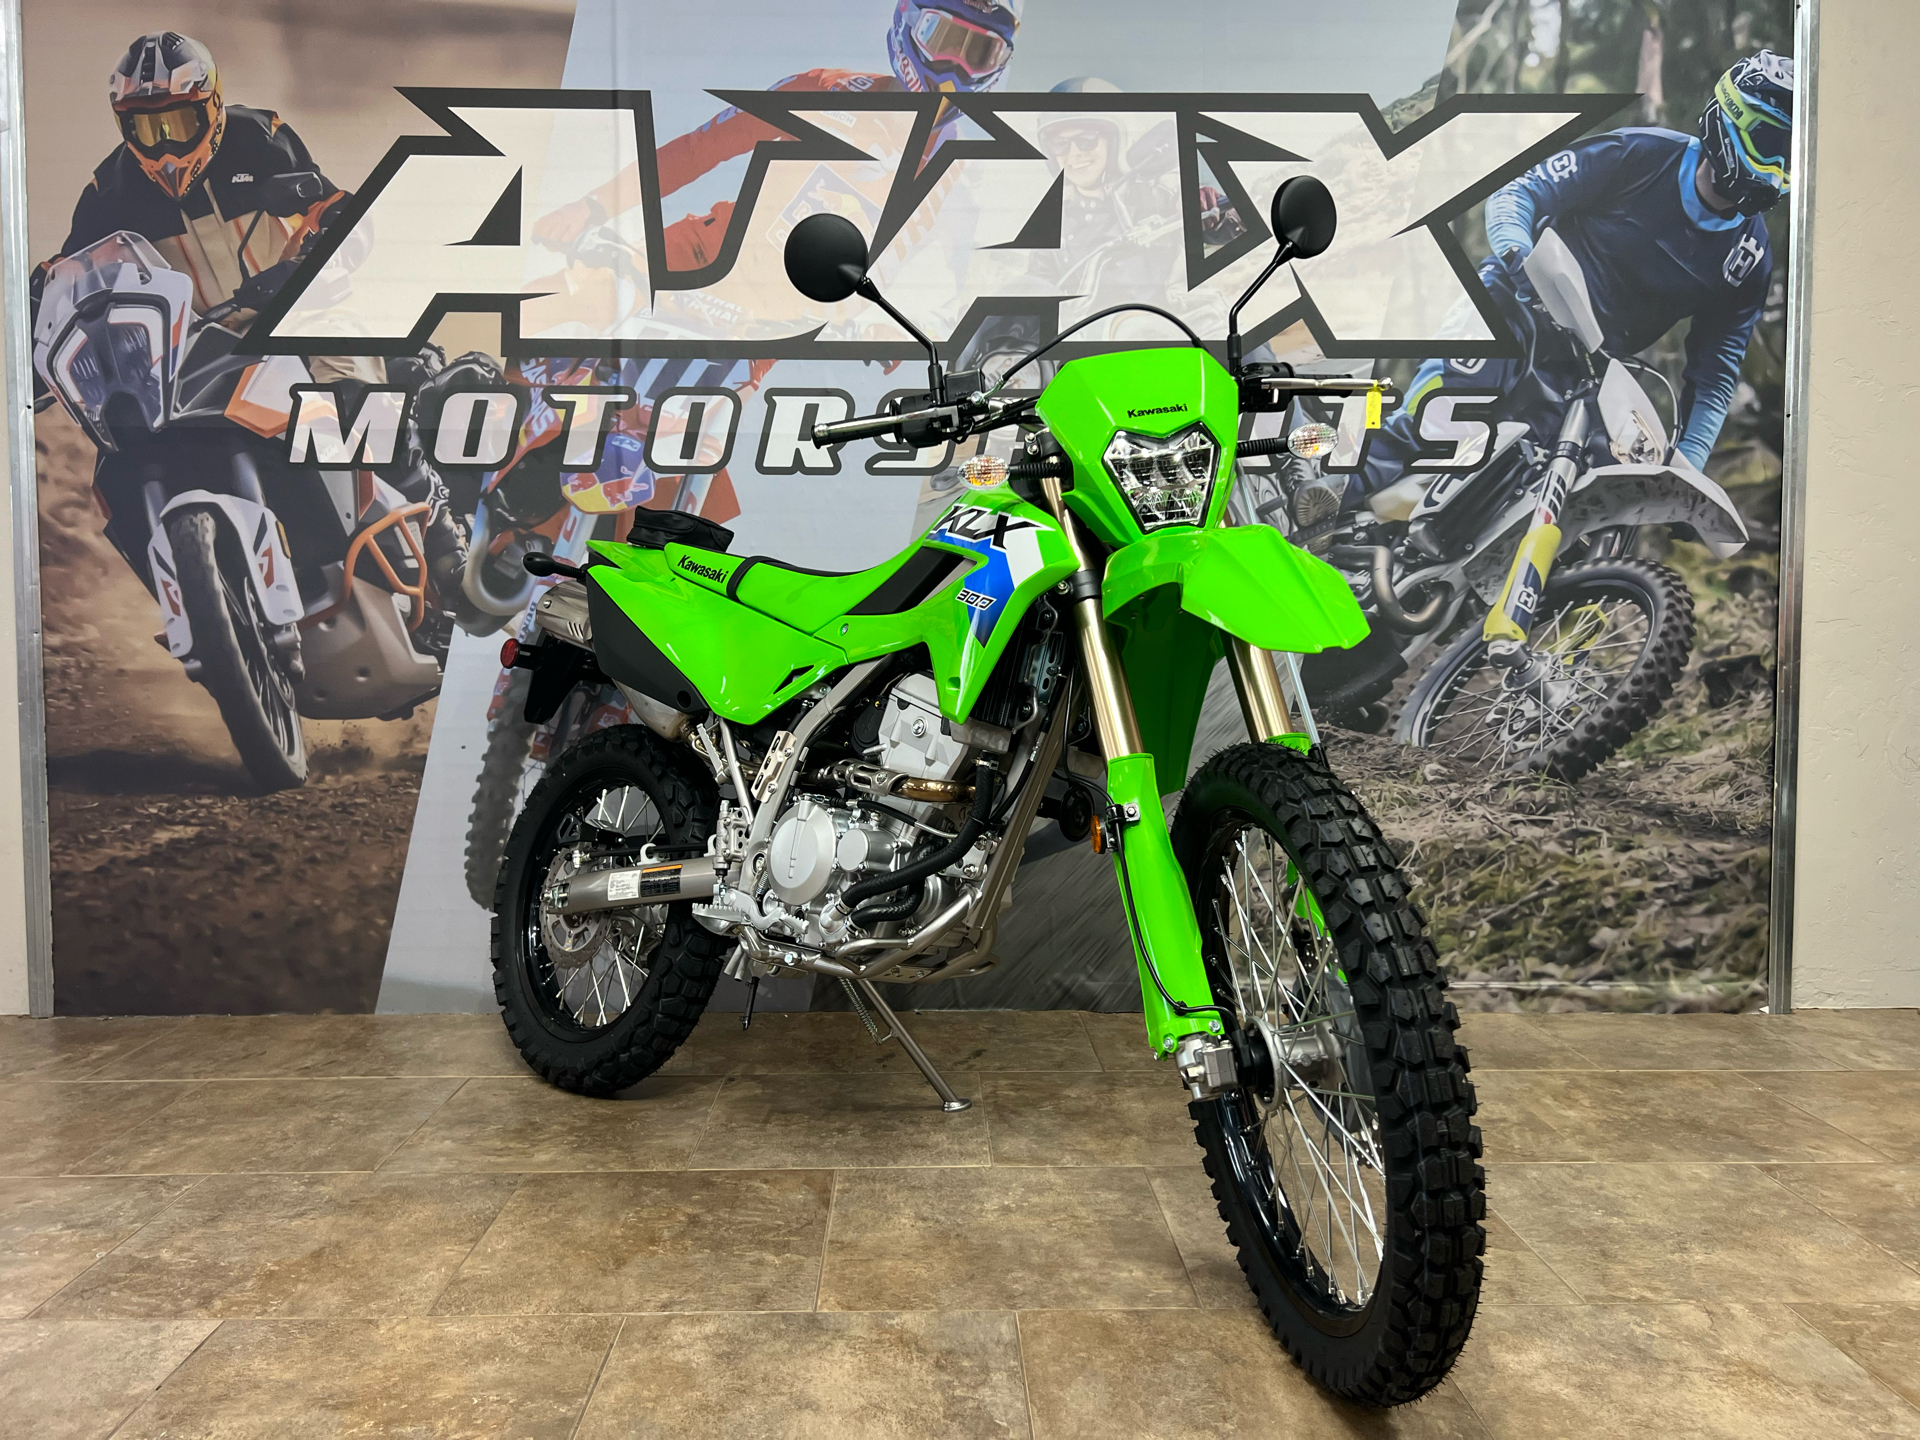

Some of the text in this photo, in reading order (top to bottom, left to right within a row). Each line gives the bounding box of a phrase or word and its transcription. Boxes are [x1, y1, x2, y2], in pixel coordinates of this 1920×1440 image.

[240, 90, 1636, 356] AJAX
[1126, 403, 1189, 419] Kawasaki
[931, 503, 1048, 552] KLX
[676, 554, 730, 584] Kawasaki
[955, 587, 997, 611] 300
